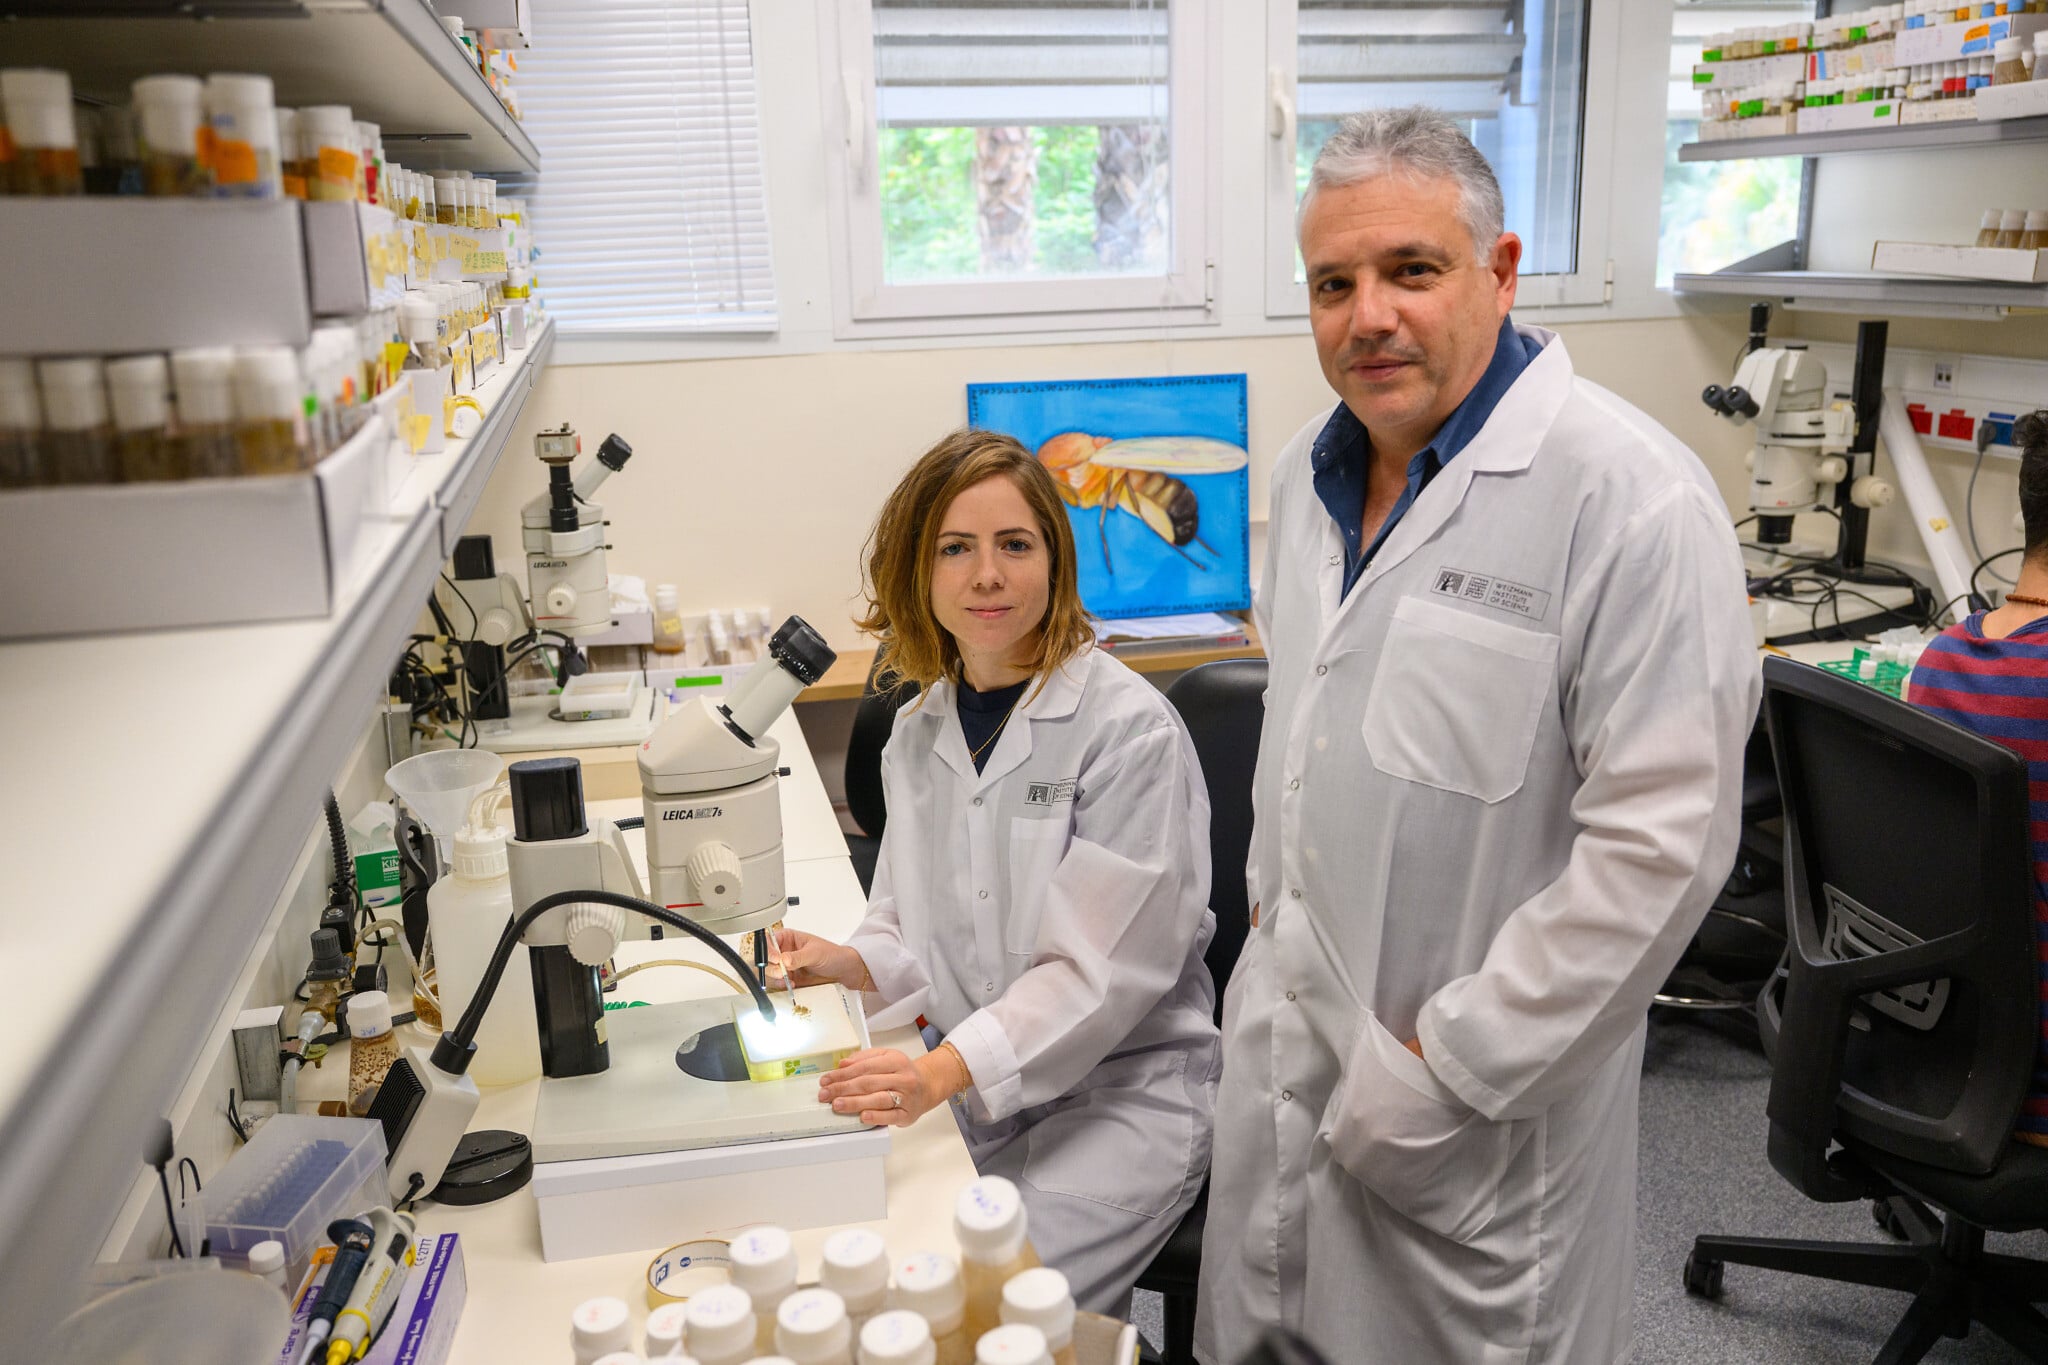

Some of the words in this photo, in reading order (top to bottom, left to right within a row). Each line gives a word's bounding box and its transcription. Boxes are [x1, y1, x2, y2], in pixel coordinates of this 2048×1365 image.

[1492, 590, 1527, 604] INSTITUTE
[1496, 583, 1533, 597] WEIZMANN
[1490, 596, 1500, 604] OF
[1501, 599, 1530, 613] SCIENCE
[662, 809, 693, 821] LEICA
[418, 1238, 433, 1256] 2777
